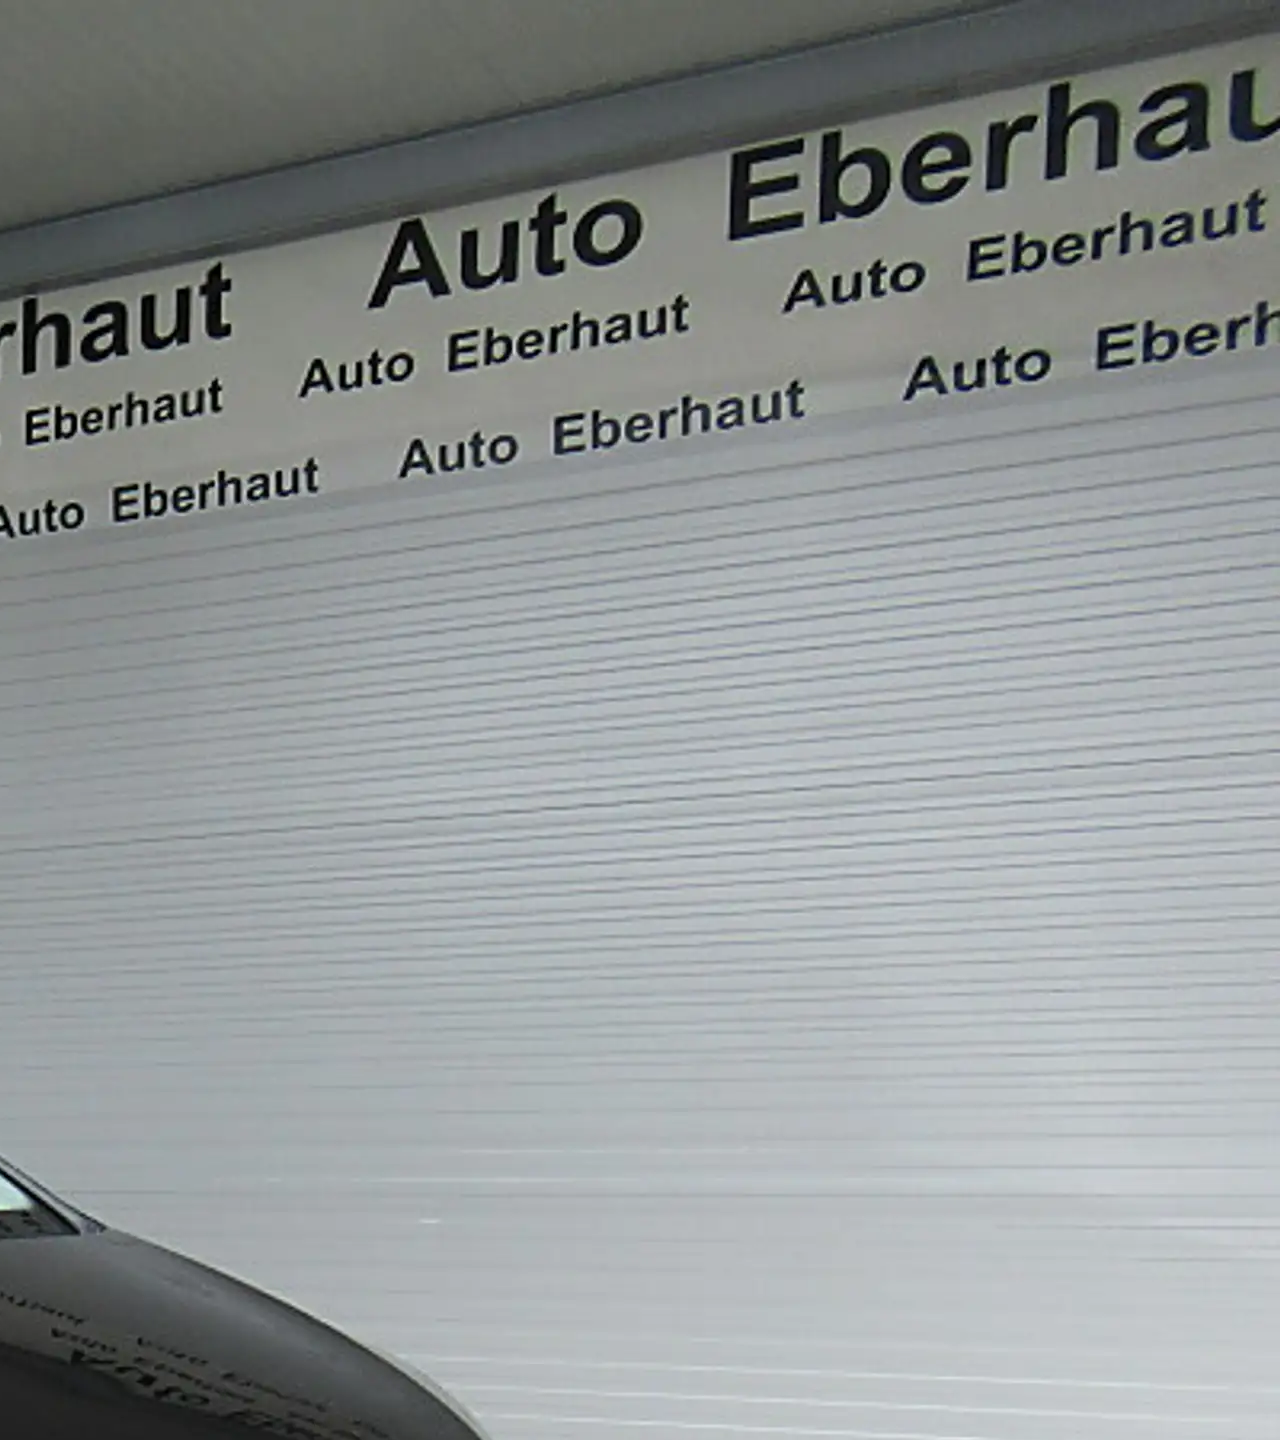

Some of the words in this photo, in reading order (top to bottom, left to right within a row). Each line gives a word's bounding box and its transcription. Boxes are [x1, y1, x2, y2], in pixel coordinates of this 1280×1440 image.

[368, 195, 642, 309] Auto
[783, 259, 925, 313] Auto
[967, 189, 1267, 281] Eberhaut
[299, 350, 414, 397] Auto
[448, 295, 689, 372] Eberhaut
[903, 346, 1051, 400] Auto
[26, 378, 222, 445] Eberhaut
[399, 432, 518, 478] Auto
[554, 380, 804, 455] Eberhaut
[113, 458, 318, 522] Eberhaut
